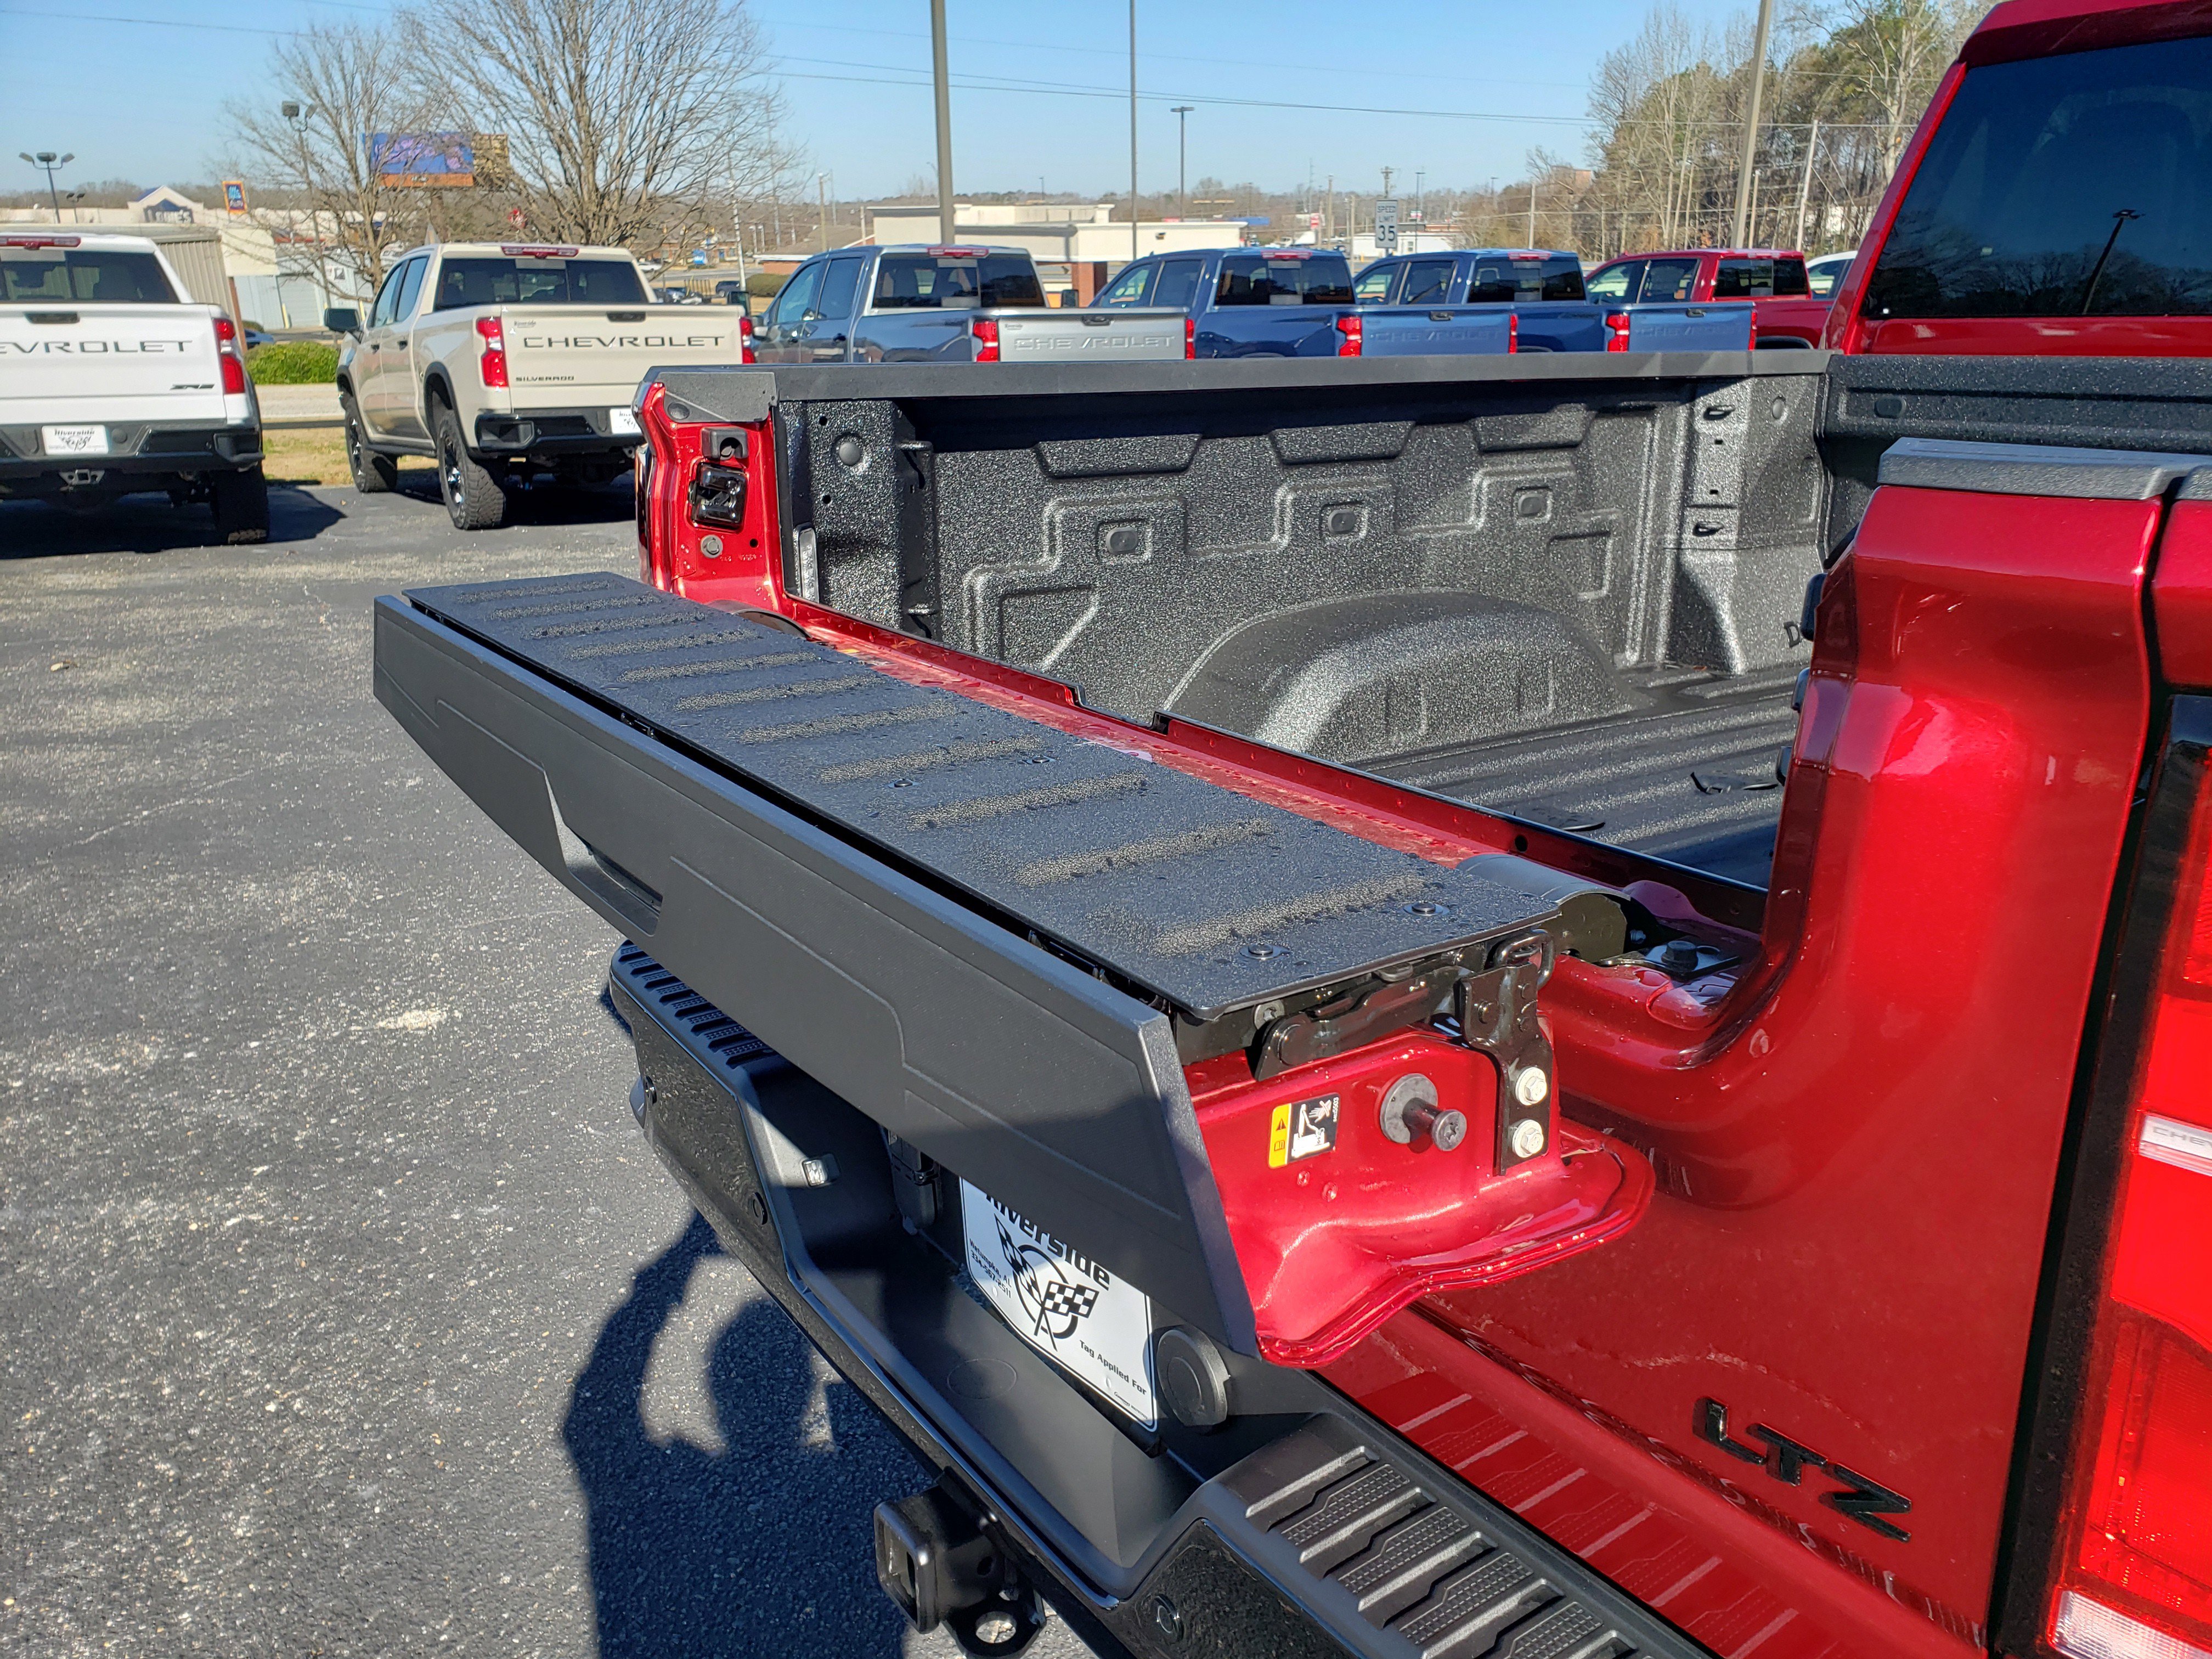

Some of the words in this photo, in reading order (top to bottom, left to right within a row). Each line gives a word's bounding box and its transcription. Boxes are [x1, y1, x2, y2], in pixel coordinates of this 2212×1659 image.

[1378, 225, 1395, 241] 35
[524, 336, 725, 348] CHEVROLET
[1014, 335, 1176, 351] CHEVROLET
[969, 1238, 1002, 1279] Wetumpka,
[1003, 1274, 1012, 1288] AL
[986, 1194, 1110, 1291] iverside
[1079, 1339, 1095, 1358] Tag
[1097, 1353, 1130, 1384] Applied
[1132, 1379, 1147, 1395] For
[1692, 1396, 1912, 1543] LTZ
